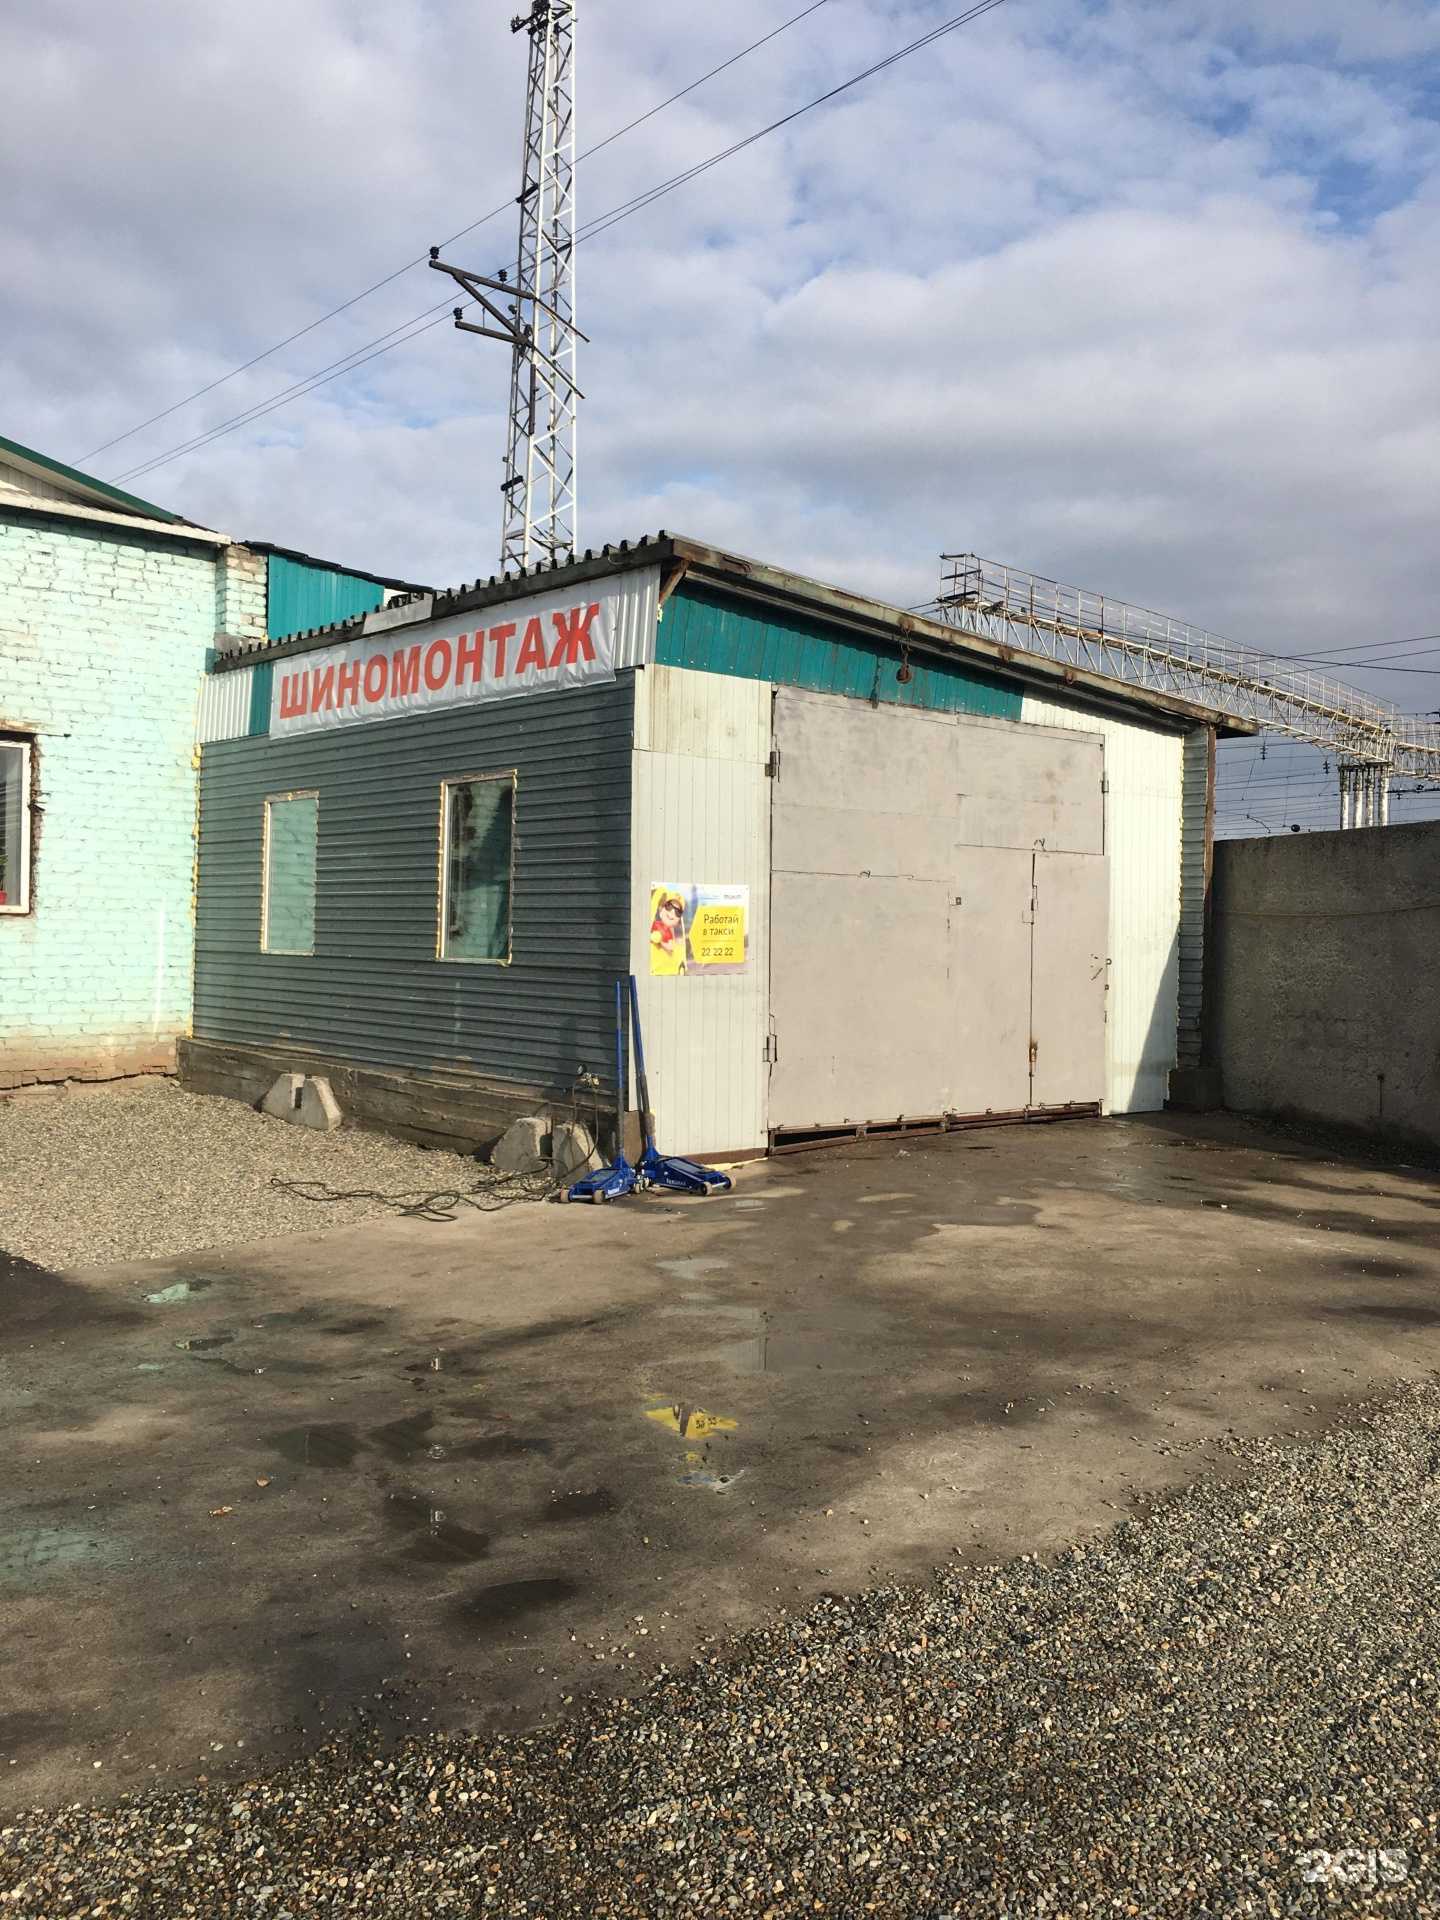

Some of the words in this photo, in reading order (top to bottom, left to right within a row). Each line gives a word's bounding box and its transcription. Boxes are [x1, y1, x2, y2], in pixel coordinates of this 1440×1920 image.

[279, 602, 599, 719] ШИНОМОНТАЖ
[703, 913, 739, 924] Работай
[710, 927, 735, 936] такси
[701, 947, 711, 957] 22
[713, 947, 723, 957] 22
[724, 947, 734, 957] 22
